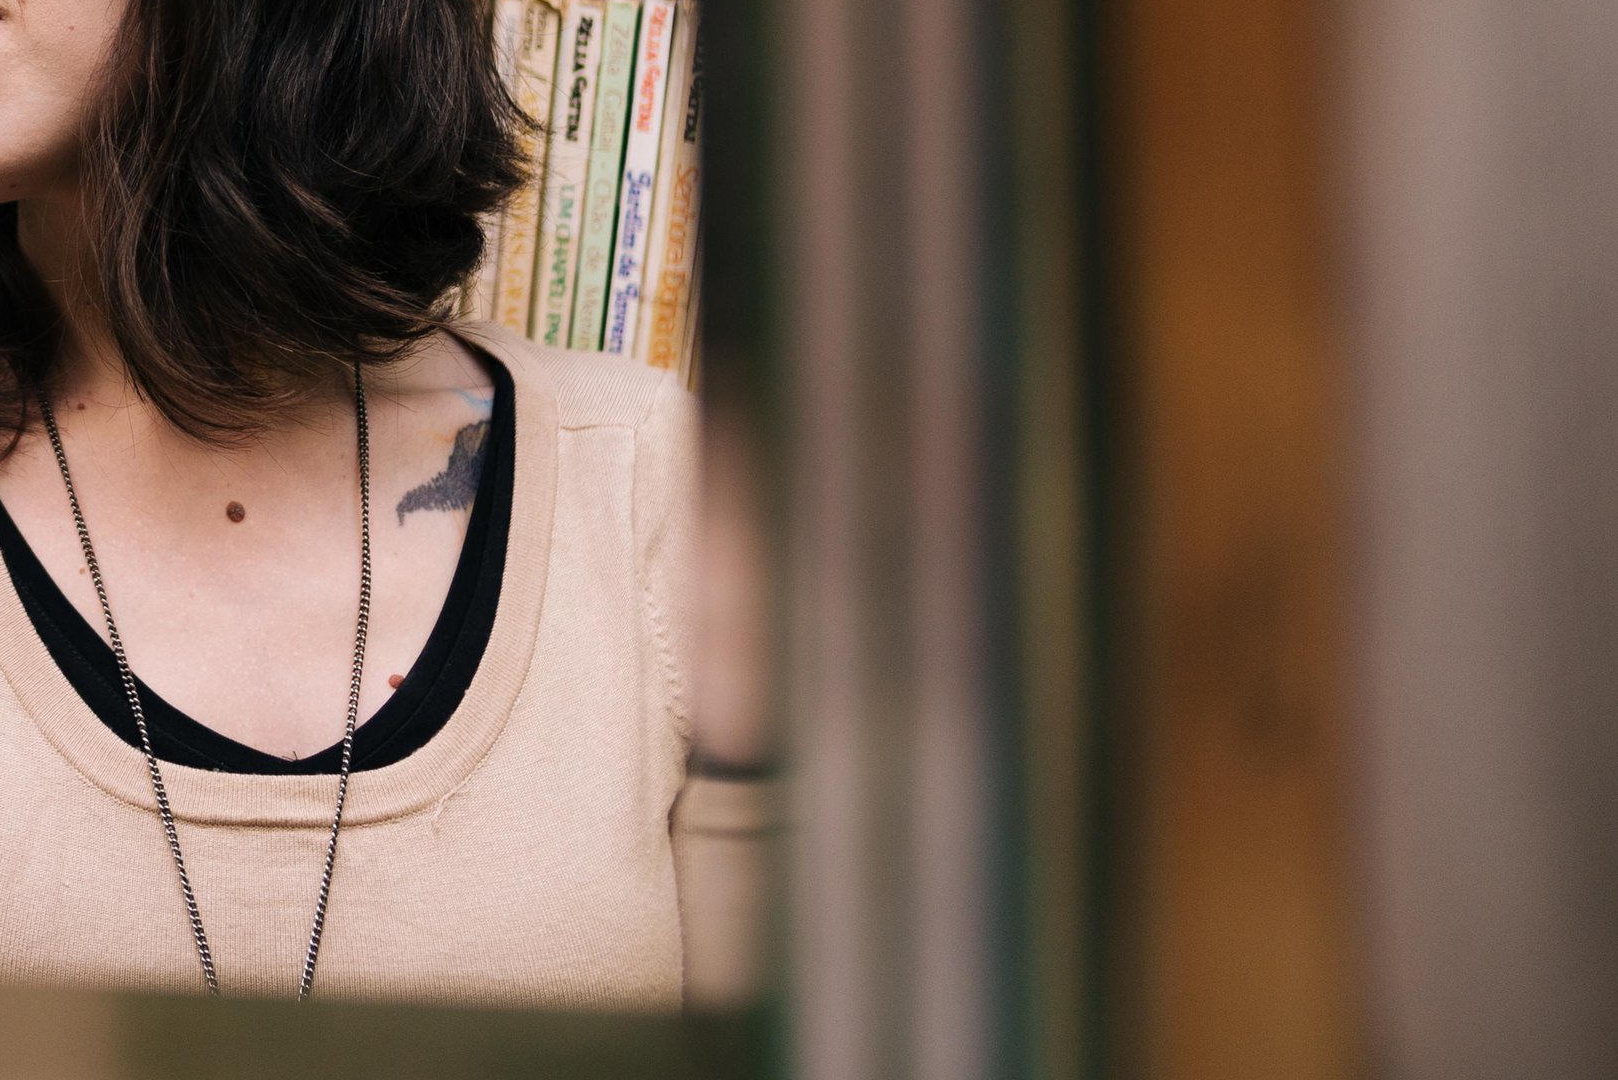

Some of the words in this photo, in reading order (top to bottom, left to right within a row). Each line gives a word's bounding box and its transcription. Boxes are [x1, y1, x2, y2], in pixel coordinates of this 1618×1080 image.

[565, 75, 588, 142] GATTAI
[636, 65, 661, 132] GATTAI
[559, 183, 576, 218] UM
[621, 169, 651, 251] Jardim
[666, 162, 699, 265] Senhora
[617, 253, 636, 278] de
